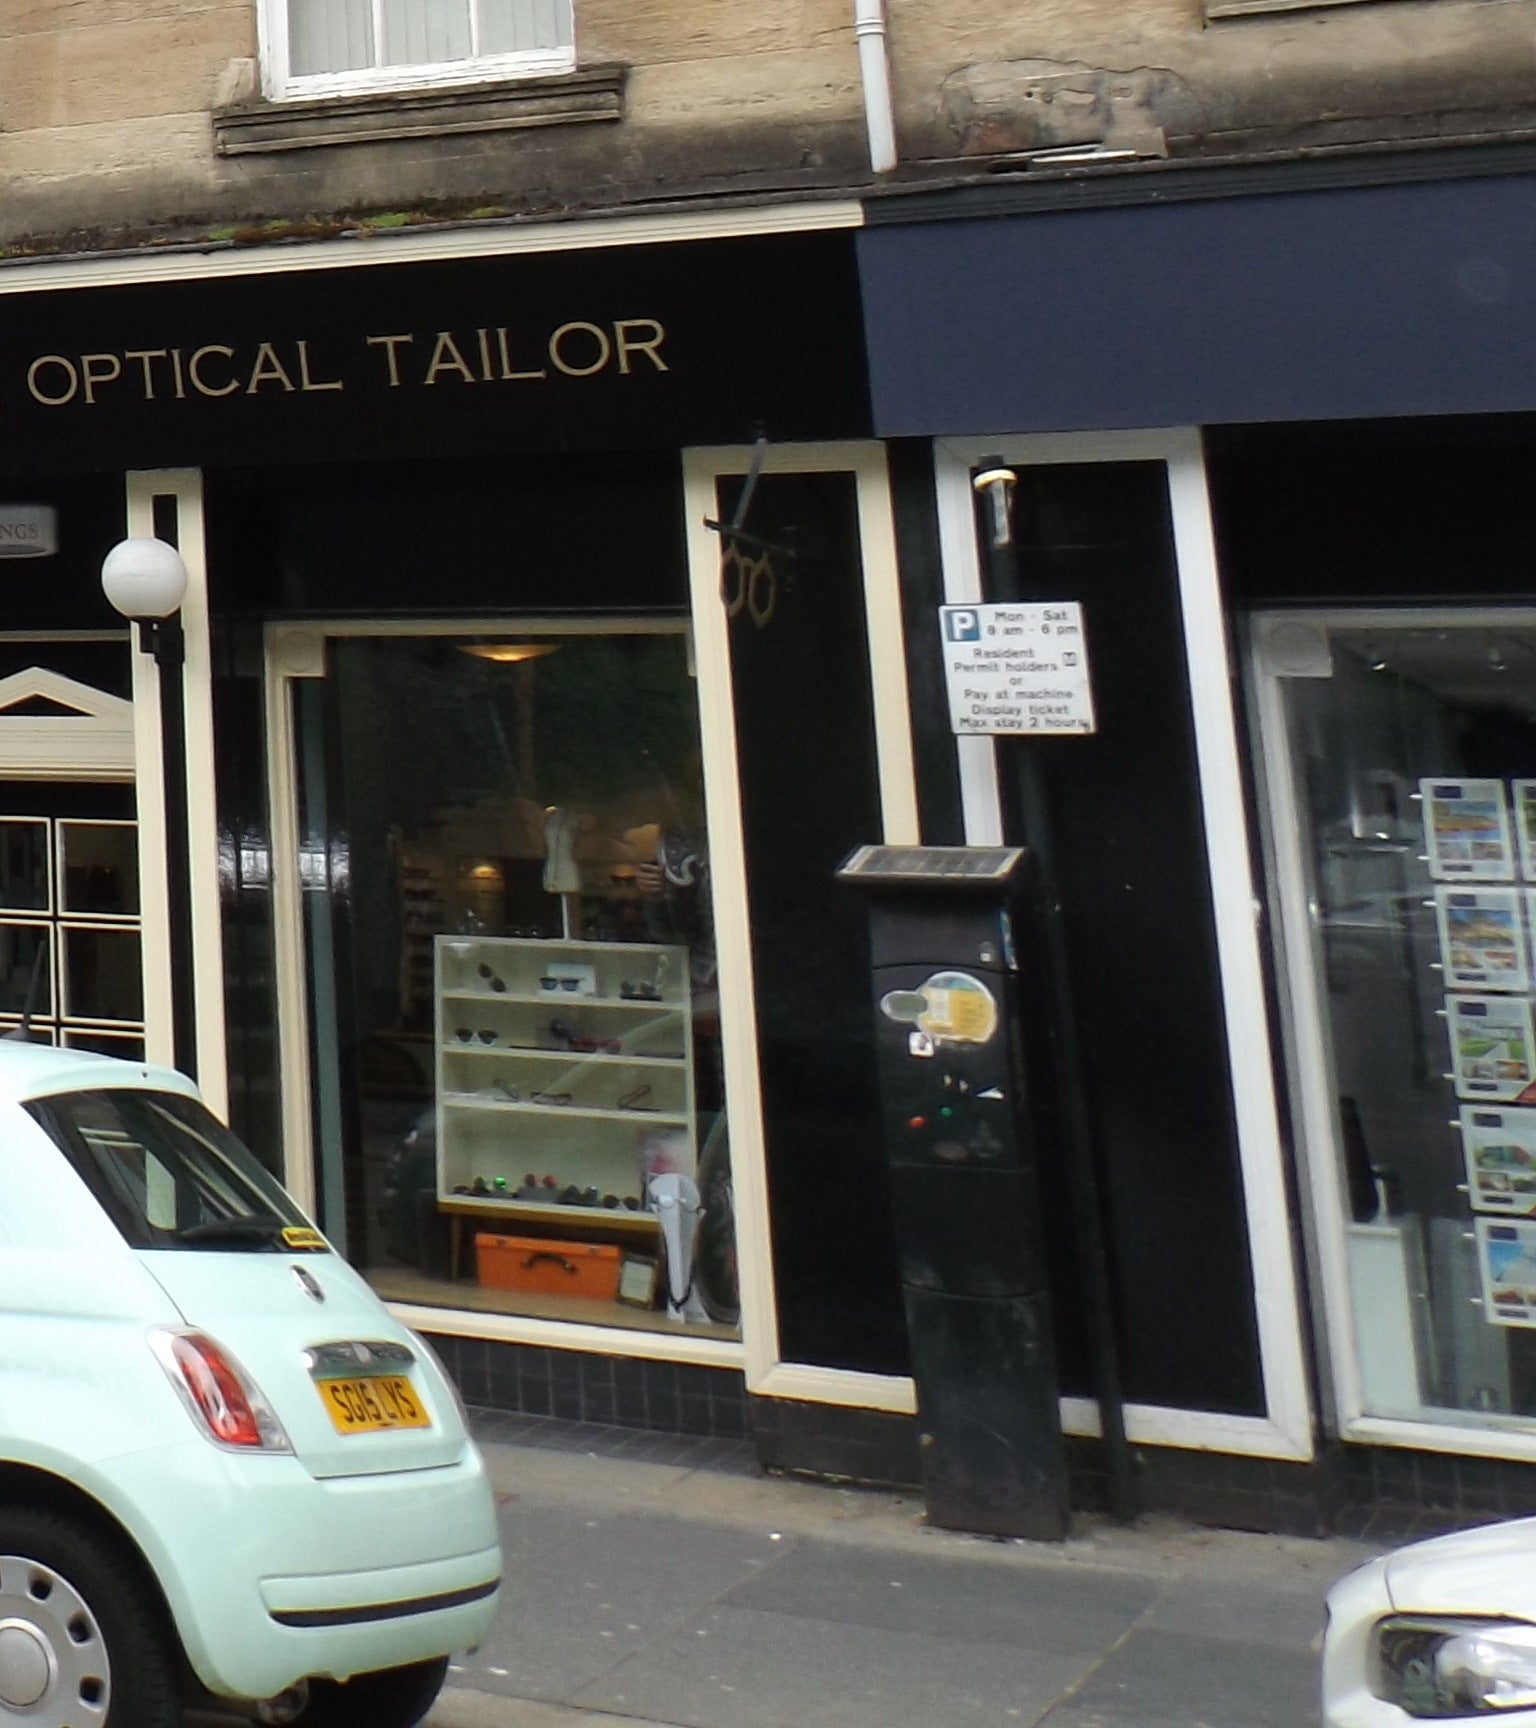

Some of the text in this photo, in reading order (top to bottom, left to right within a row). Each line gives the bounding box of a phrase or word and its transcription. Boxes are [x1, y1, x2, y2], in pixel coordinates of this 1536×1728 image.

[28, 339, 343, 406] OPTICAL
[366, 318, 670, 387] TAILOR
[994, 611, 1025, 622] Mon
[1043, 609, 1069, 621] Sat
[951, 611, 975, 640] P
[1002, 626, 1023, 635] am
[1057, 626, 1078, 636] pm
[973, 648, 1035, 659] Resident
[954, 661, 1058, 672] Permit holders
[1009, 676, 1024, 686] or
[964, 688, 1074, 701] Pay at machine
[971, 704, 1070, 716] Display ticket
[959, 717, 987, 728] Max
[993, 717, 1023, 729] stay
[1029, 717, 1038, 728] 2
